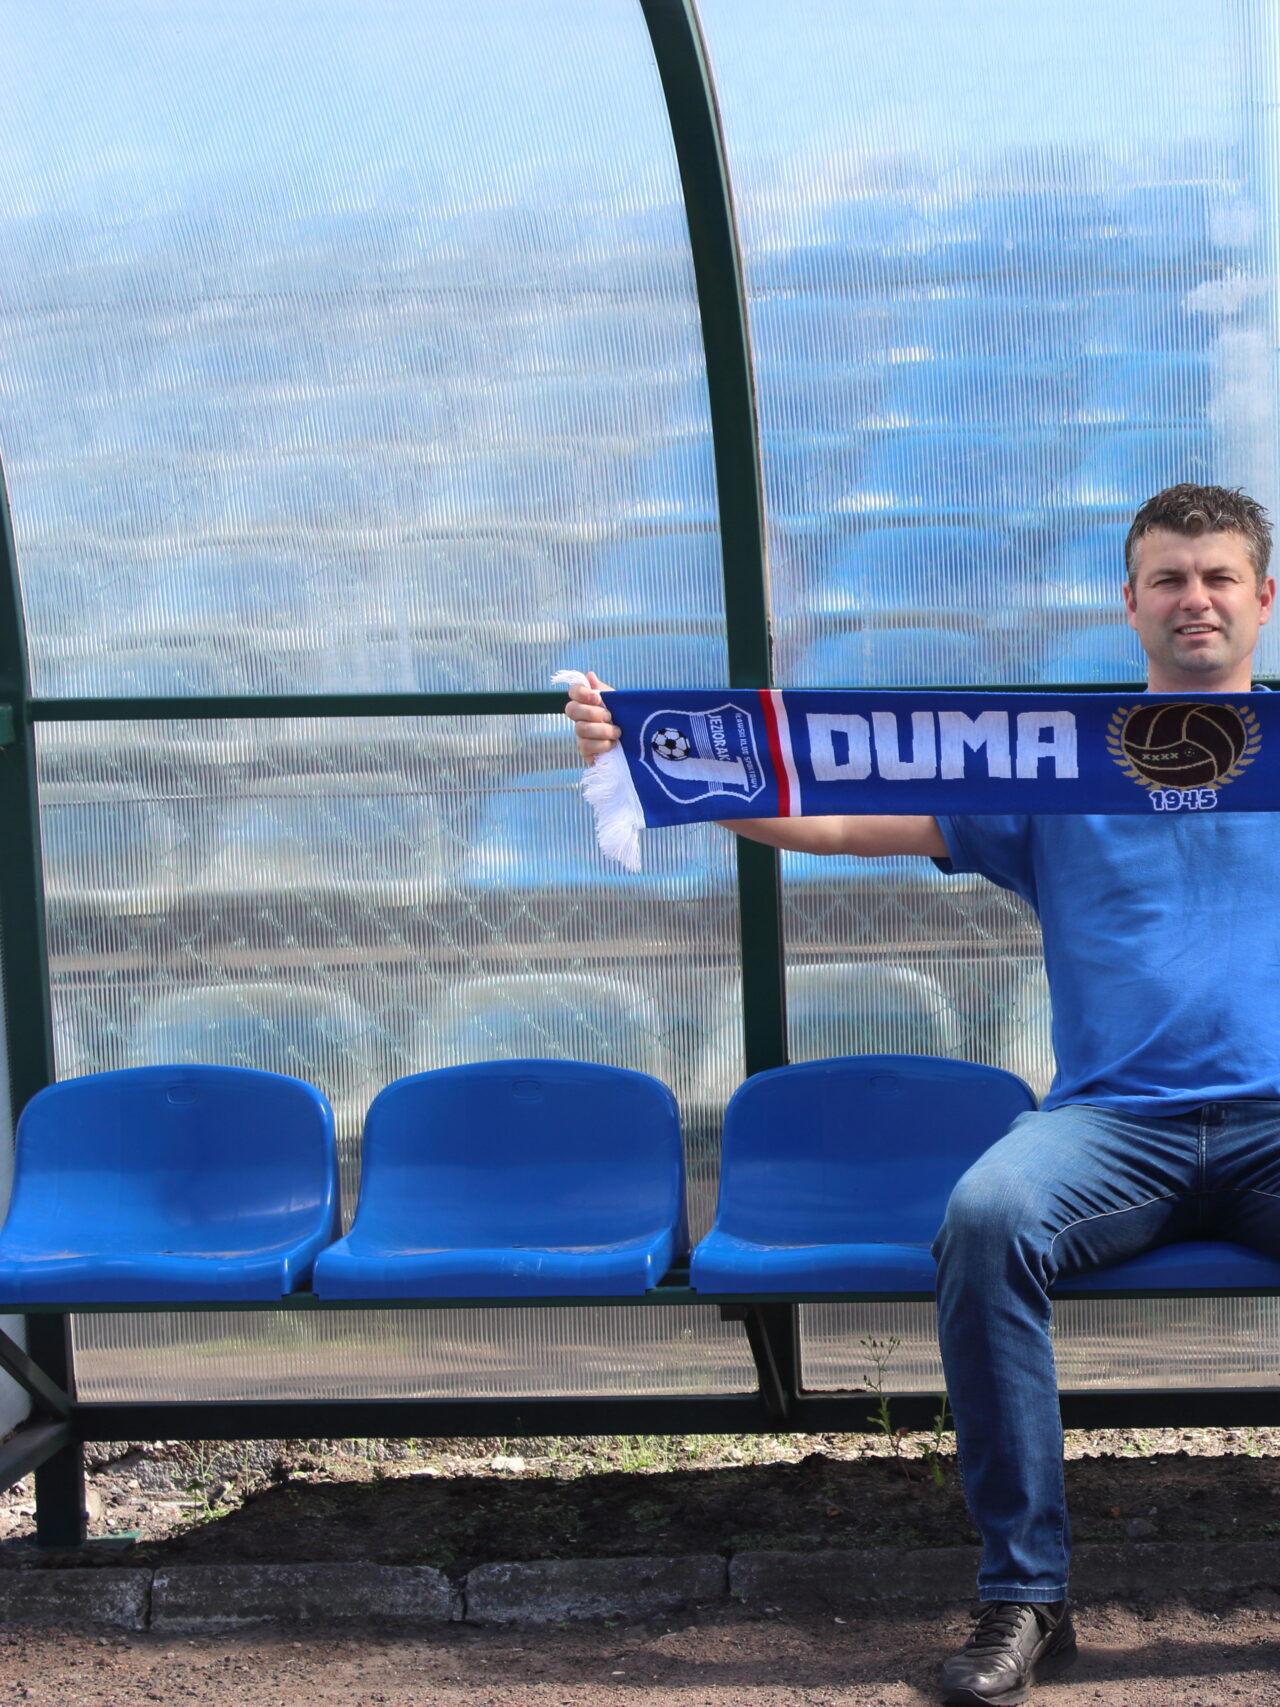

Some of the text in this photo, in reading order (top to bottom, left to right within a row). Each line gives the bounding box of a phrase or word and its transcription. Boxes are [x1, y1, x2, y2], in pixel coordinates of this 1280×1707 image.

[708, 714, 731, 760] JEZIORAK
[807, 711, 1079, 781] DUMA
[1148, 789, 1218, 811] 1945
